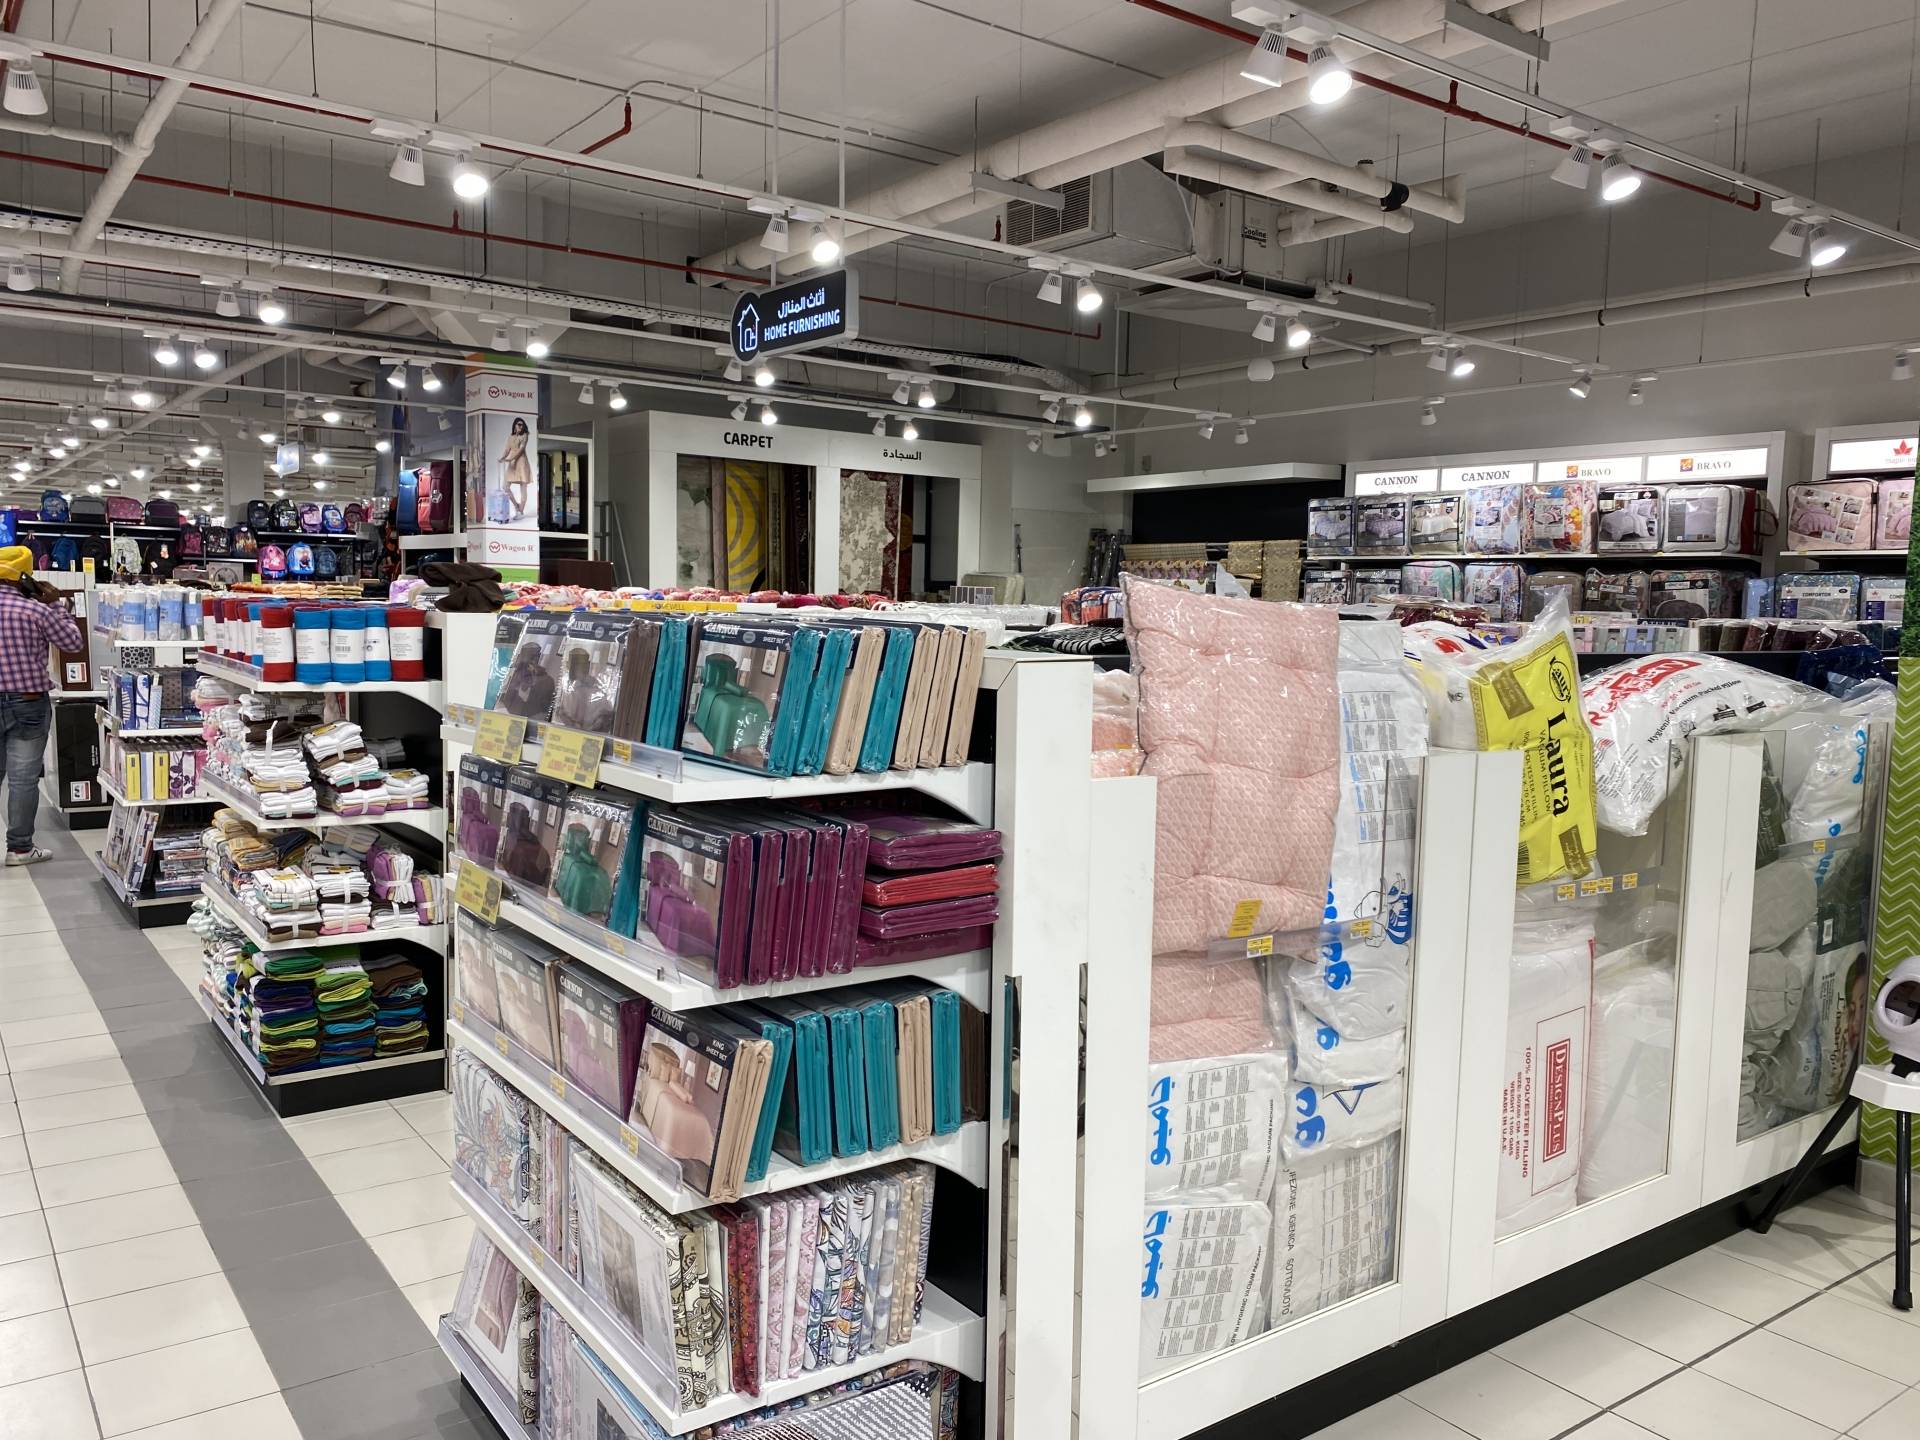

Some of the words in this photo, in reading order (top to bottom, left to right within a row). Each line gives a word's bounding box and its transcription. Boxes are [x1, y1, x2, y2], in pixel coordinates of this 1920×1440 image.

[777, 297, 806, 319] المنازل
[807, 287, 825, 308] أثاث
[764, 323, 787, 341] HOME
[788, 309, 840, 335] FURNISHING
[500, 388, 525, 399] Wagon
[527, 391, 533, 399] R
[723, 432, 774, 449] CARPET
[882, 448, 922, 461] السجادة
[1461, 470, 1511, 482] CANNON
[1580, 468, 1612, 477] BRAVO
[1696, 461, 1732, 471] BRAVO
[1374, 475, 1418, 486] CANNON
[501, 543, 526, 552] Wagon
[527, 544, 534, 552] R
[705, 623, 740, 635] CANNON
[1549, 655, 1571, 703] Laura
[1669, 694, 1698, 715] Vacuum
[1538, 729, 1547, 773] VACUUM
[1547, 707, 1570, 818] Laura
[1542, 774, 1551, 813] PILLOW
[648, 817, 679, 837] CANNON
[560, 975, 583, 998] CANNON
[651, 1006, 685, 1032] CANNON
[705, 1045, 719, 1056] SHEET
[718, 1052, 728, 1061] SET
[712, 1039, 725, 1051] KING
[1522, 1076, 1531, 1137] POLYESTER
[1288, 1214, 1297, 1252] IGIENICA
[1236, 1298, 1248, 1325] HYGIENIC
[1244, 1272, 1256, 1297] VACUUM
